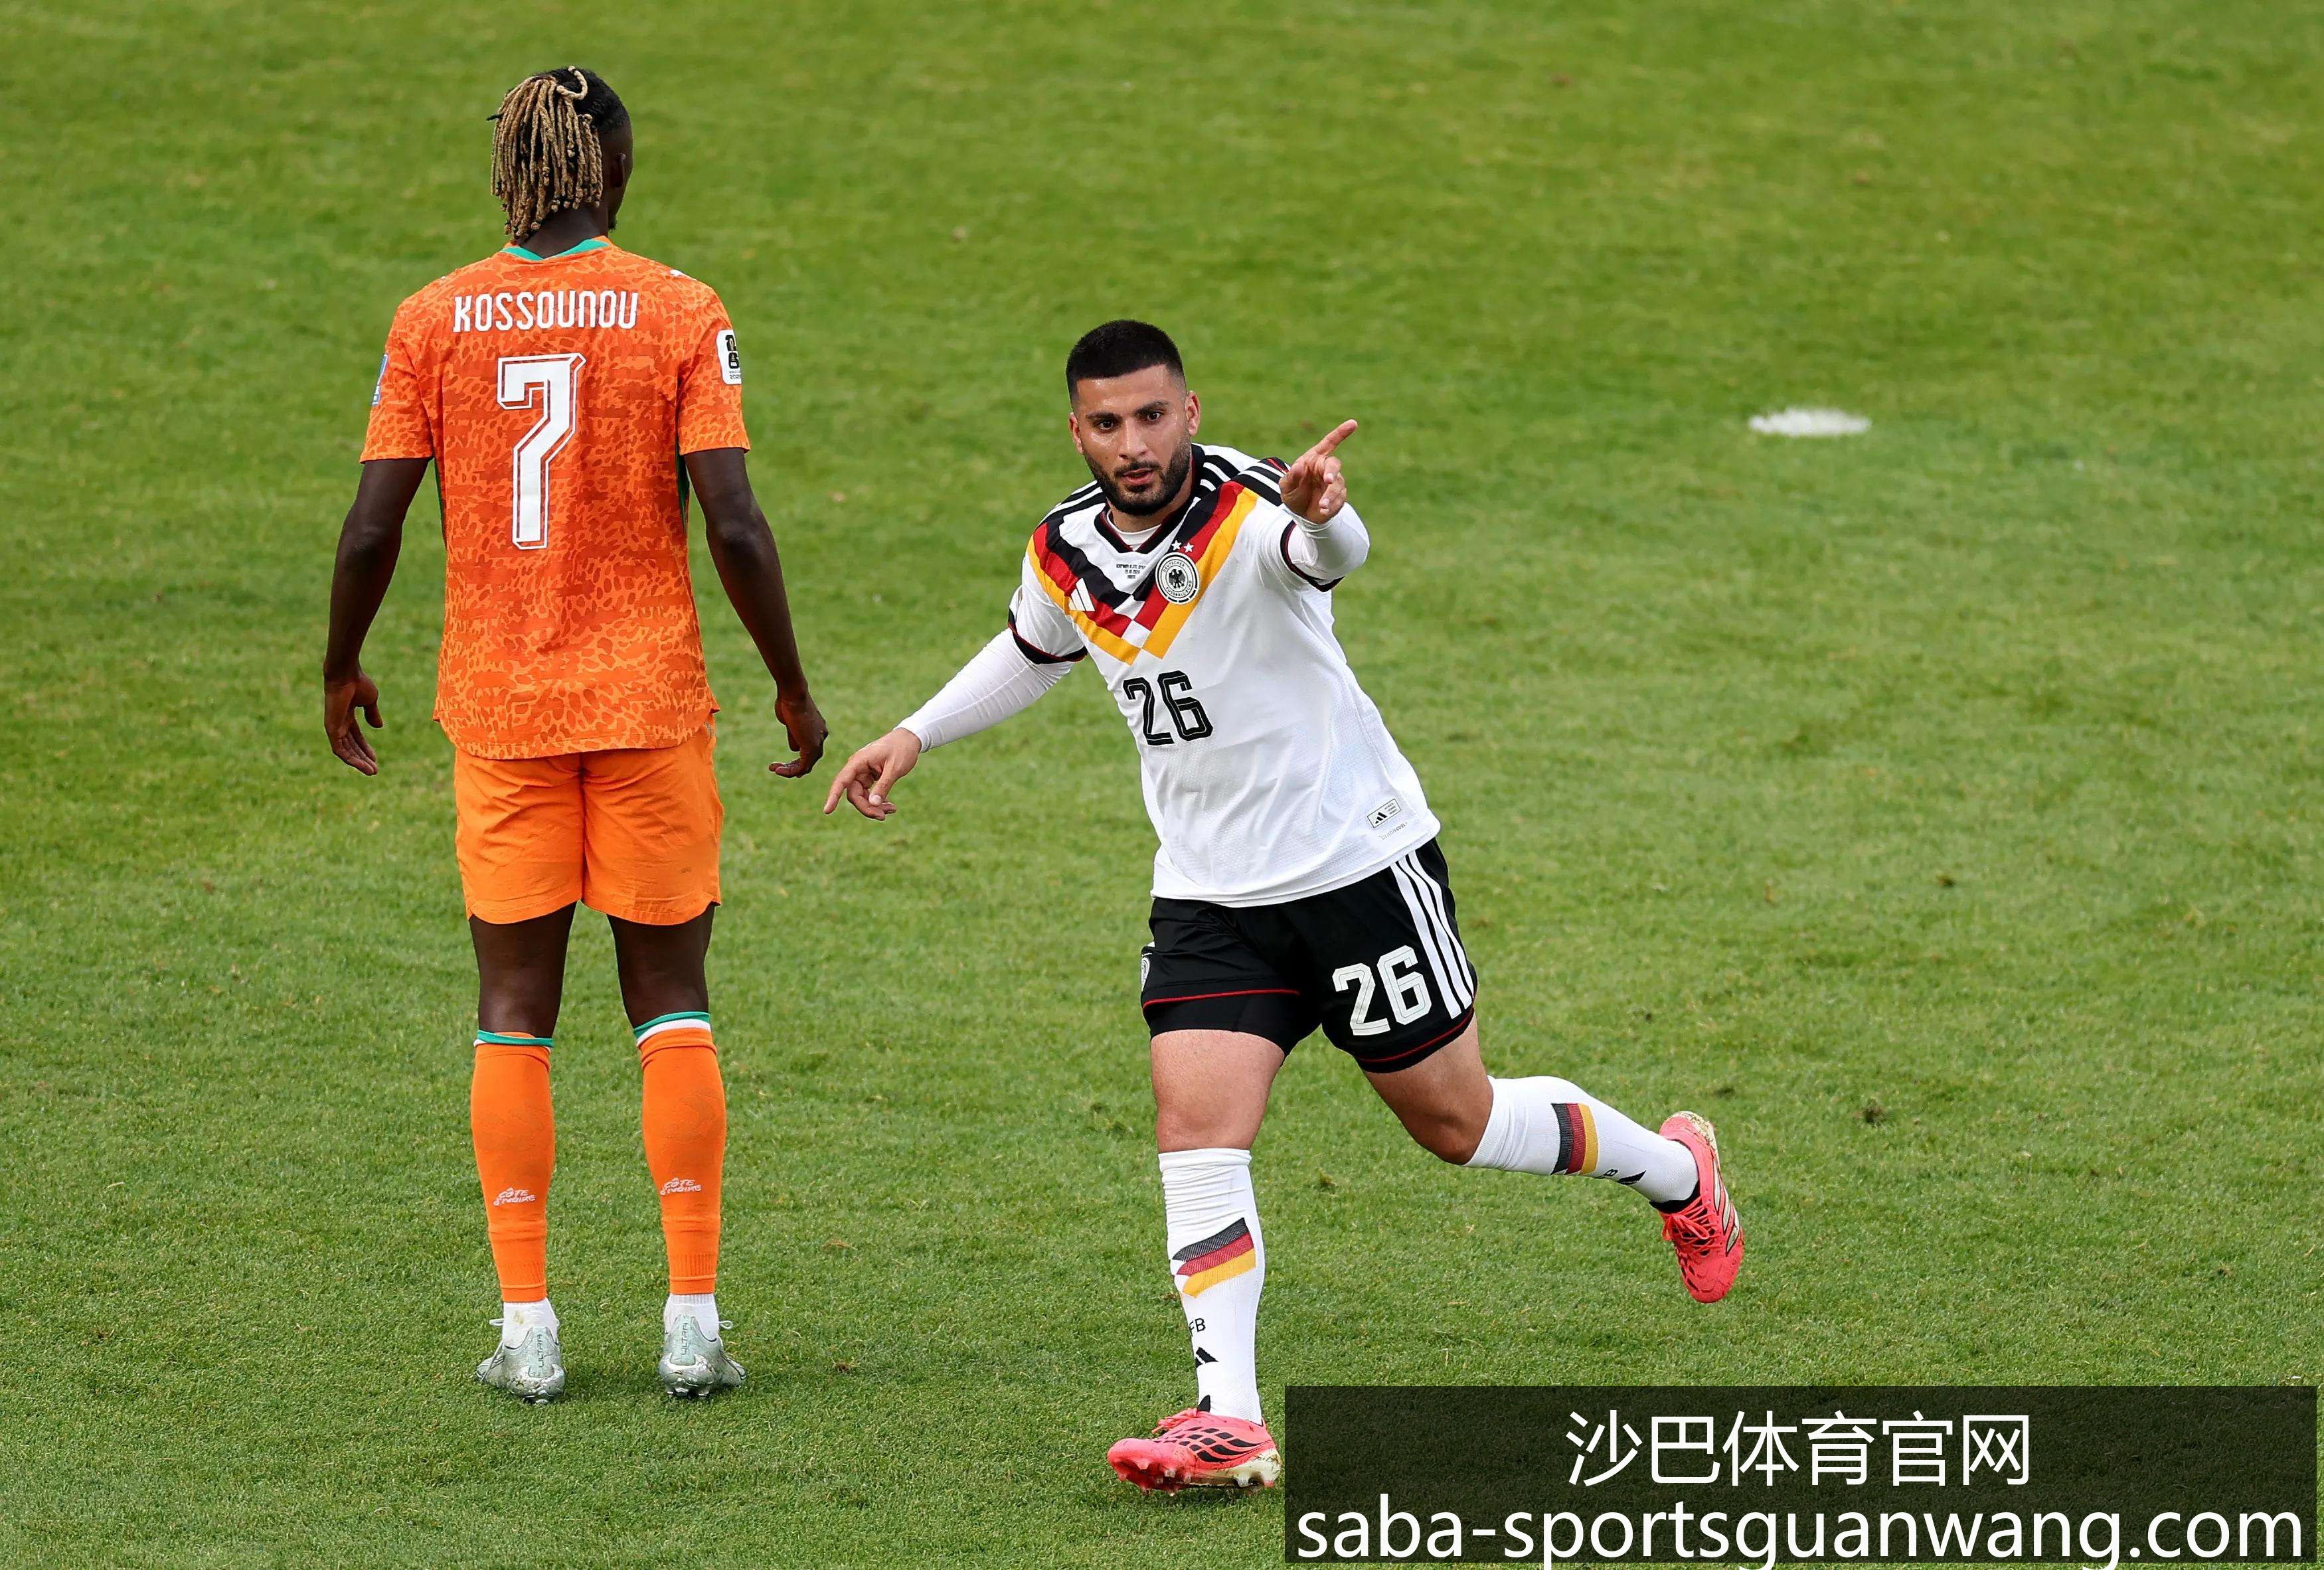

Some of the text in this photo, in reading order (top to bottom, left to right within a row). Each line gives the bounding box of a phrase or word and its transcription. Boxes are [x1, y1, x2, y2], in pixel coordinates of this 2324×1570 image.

[454, 290, 638, 333] KOSSOUNOU
[497, 353, 586, 550] 7
[1122, 670, 1214, 746] 26
[1332, 945, 1432, 1036] 26
